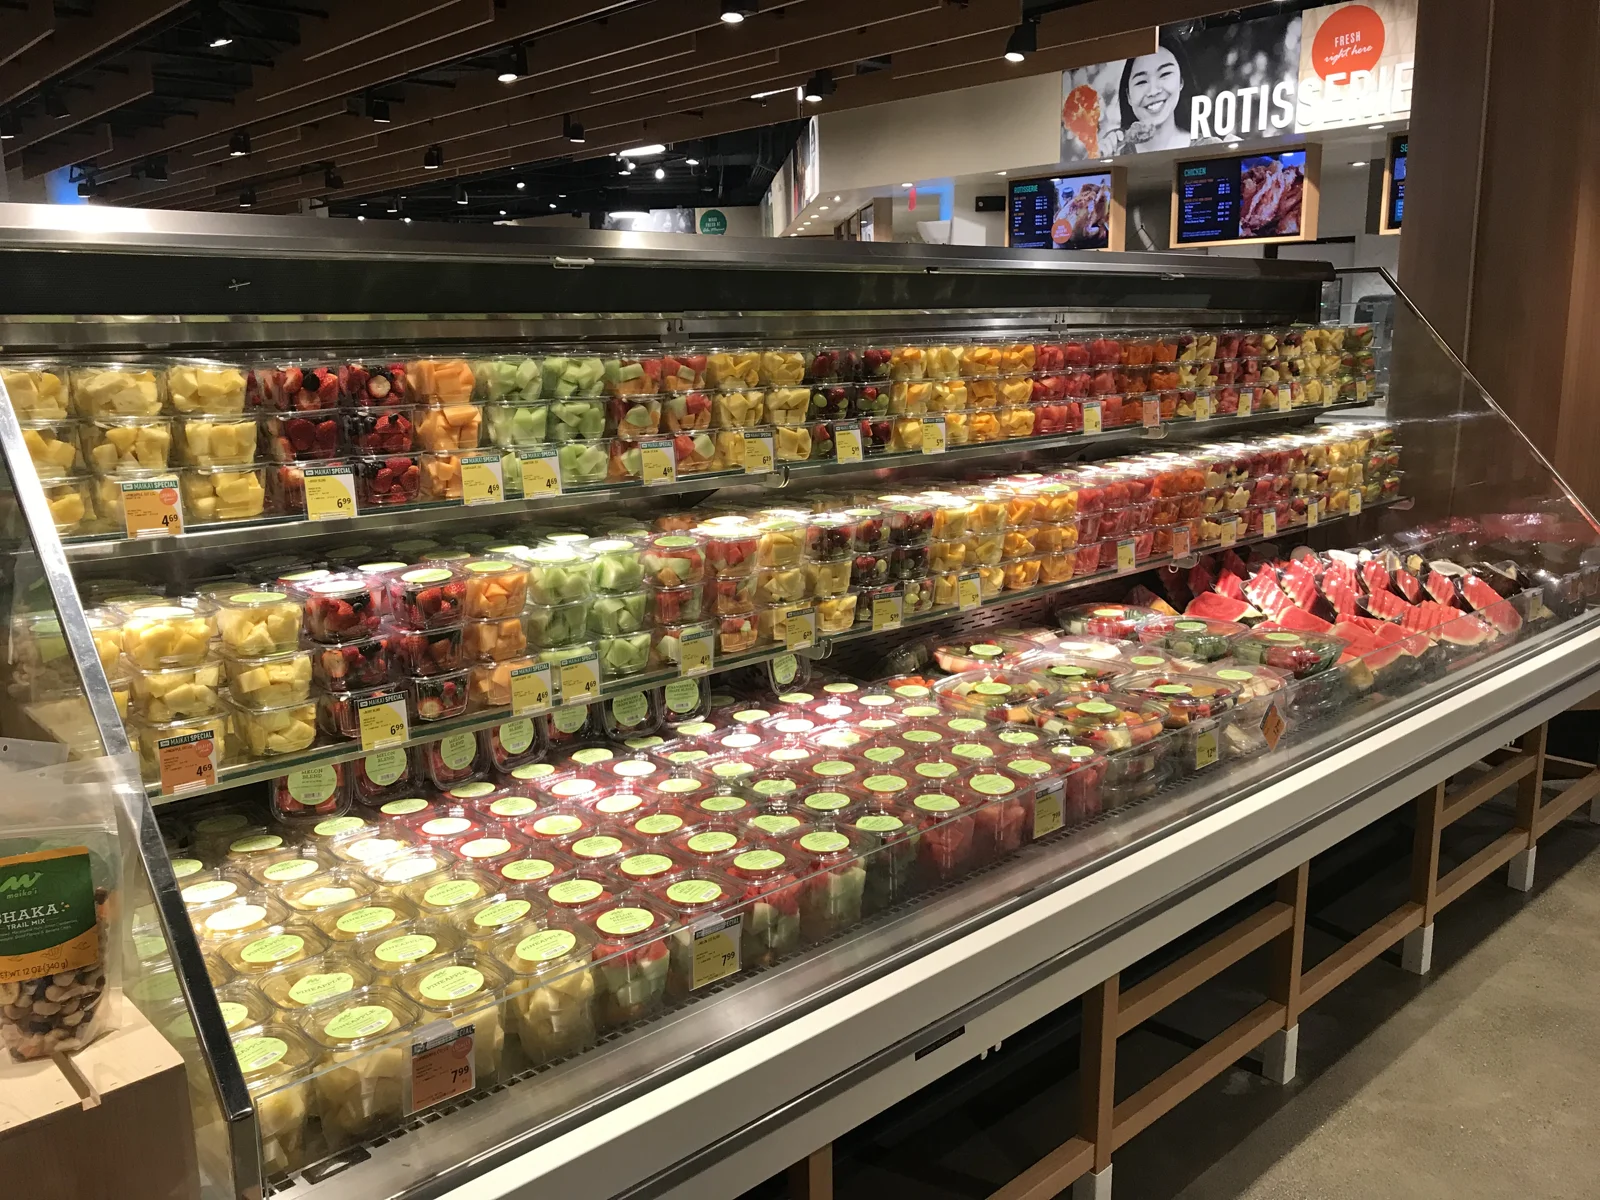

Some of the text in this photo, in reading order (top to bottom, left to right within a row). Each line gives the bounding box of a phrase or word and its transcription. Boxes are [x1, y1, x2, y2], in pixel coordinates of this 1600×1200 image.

[1334, 31, 1361, 47] FRESH
[1324, 44, 1374, 65] right here
[1184, 167, 1207, 177] CHICKEN
[663, 466, 673, 477] 469
[488, 484, 500, 495] 469
[546, 478, 558, 488] 469
[337, 498, 352, 508] 699
[162, 514, 178, 527] 469
[582, 654, 598, 662] SPECIAL
[532, 664, 549, 672] SPECIAL
[584, 680, 597, 692] 469
[385, 694, 404, 703] SPECIAL
[536, 691, 548, 703] 469
[390, 723, 404, 736] 699
[190, 731, 212, 742] SPECIAL
[196, 764, 212, 777] 469
[342, 910, 383, 924] PINEAPPLE
[6, 918, 45, 930] TRAIL MIX
[522, 933, 563, 951] PINEAPPLE
[722, 951, 736, 966] 799
[10, 970, 21, 978] WT
[22, 968, 30, 976] 12
[61, 958, 69, 969] g)
[296, 976, 343, 995] PINEAPPLE
[426, 970, 469, 990] PINEAPPLE
[332, 1009, 376, 1031] PINEAPPLE
[451, 1065, 469, 1084] 799
